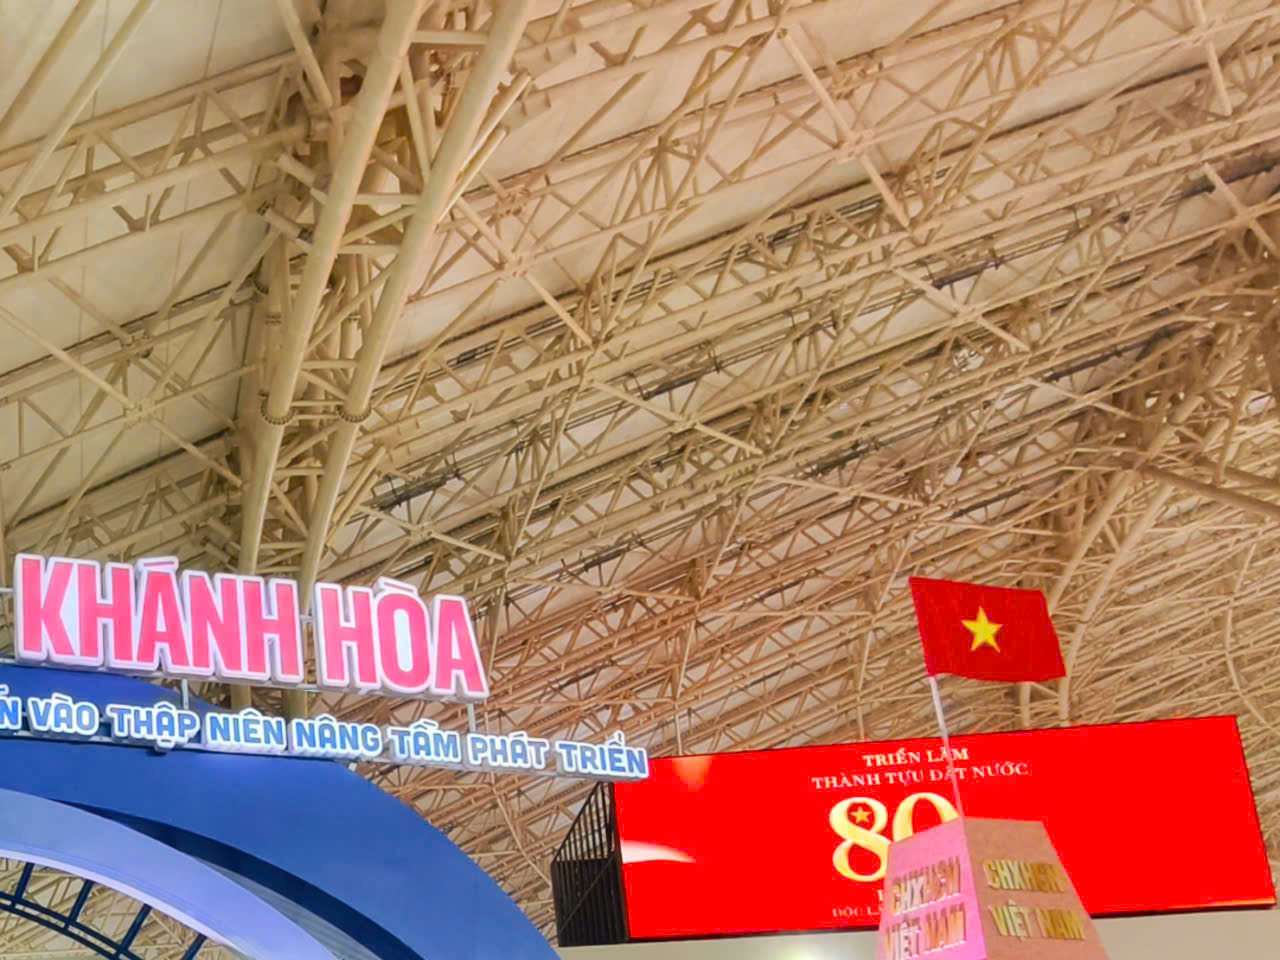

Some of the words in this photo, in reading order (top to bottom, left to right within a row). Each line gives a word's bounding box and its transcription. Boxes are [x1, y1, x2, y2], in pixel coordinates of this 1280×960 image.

[15, 553, 304, 682] KHÁNH
[314, 576, 490, 700] HÒA
[27, 693, 101, 736] VÀO
[105, 700, 200, 752] THẬP
[205, 707, 287, 751] NIÊN
[290, 712, 383, 759] NÂNG
[387, 717, 463, 764] TẦM
[466, 730, 550, 771] PHÁT
[554, 730, 649, 780] TRIỂN
[863, 747, 920, 767] TRIỂN
[812, 774, 880, 790] THÀNH
[885, 770, 923, 787] TỰU
[972, 761, 1029, 777] NƯỚC
[988, 899, 1034, 942] VIỆT
[1037, 906, 1086, 941] NAM
